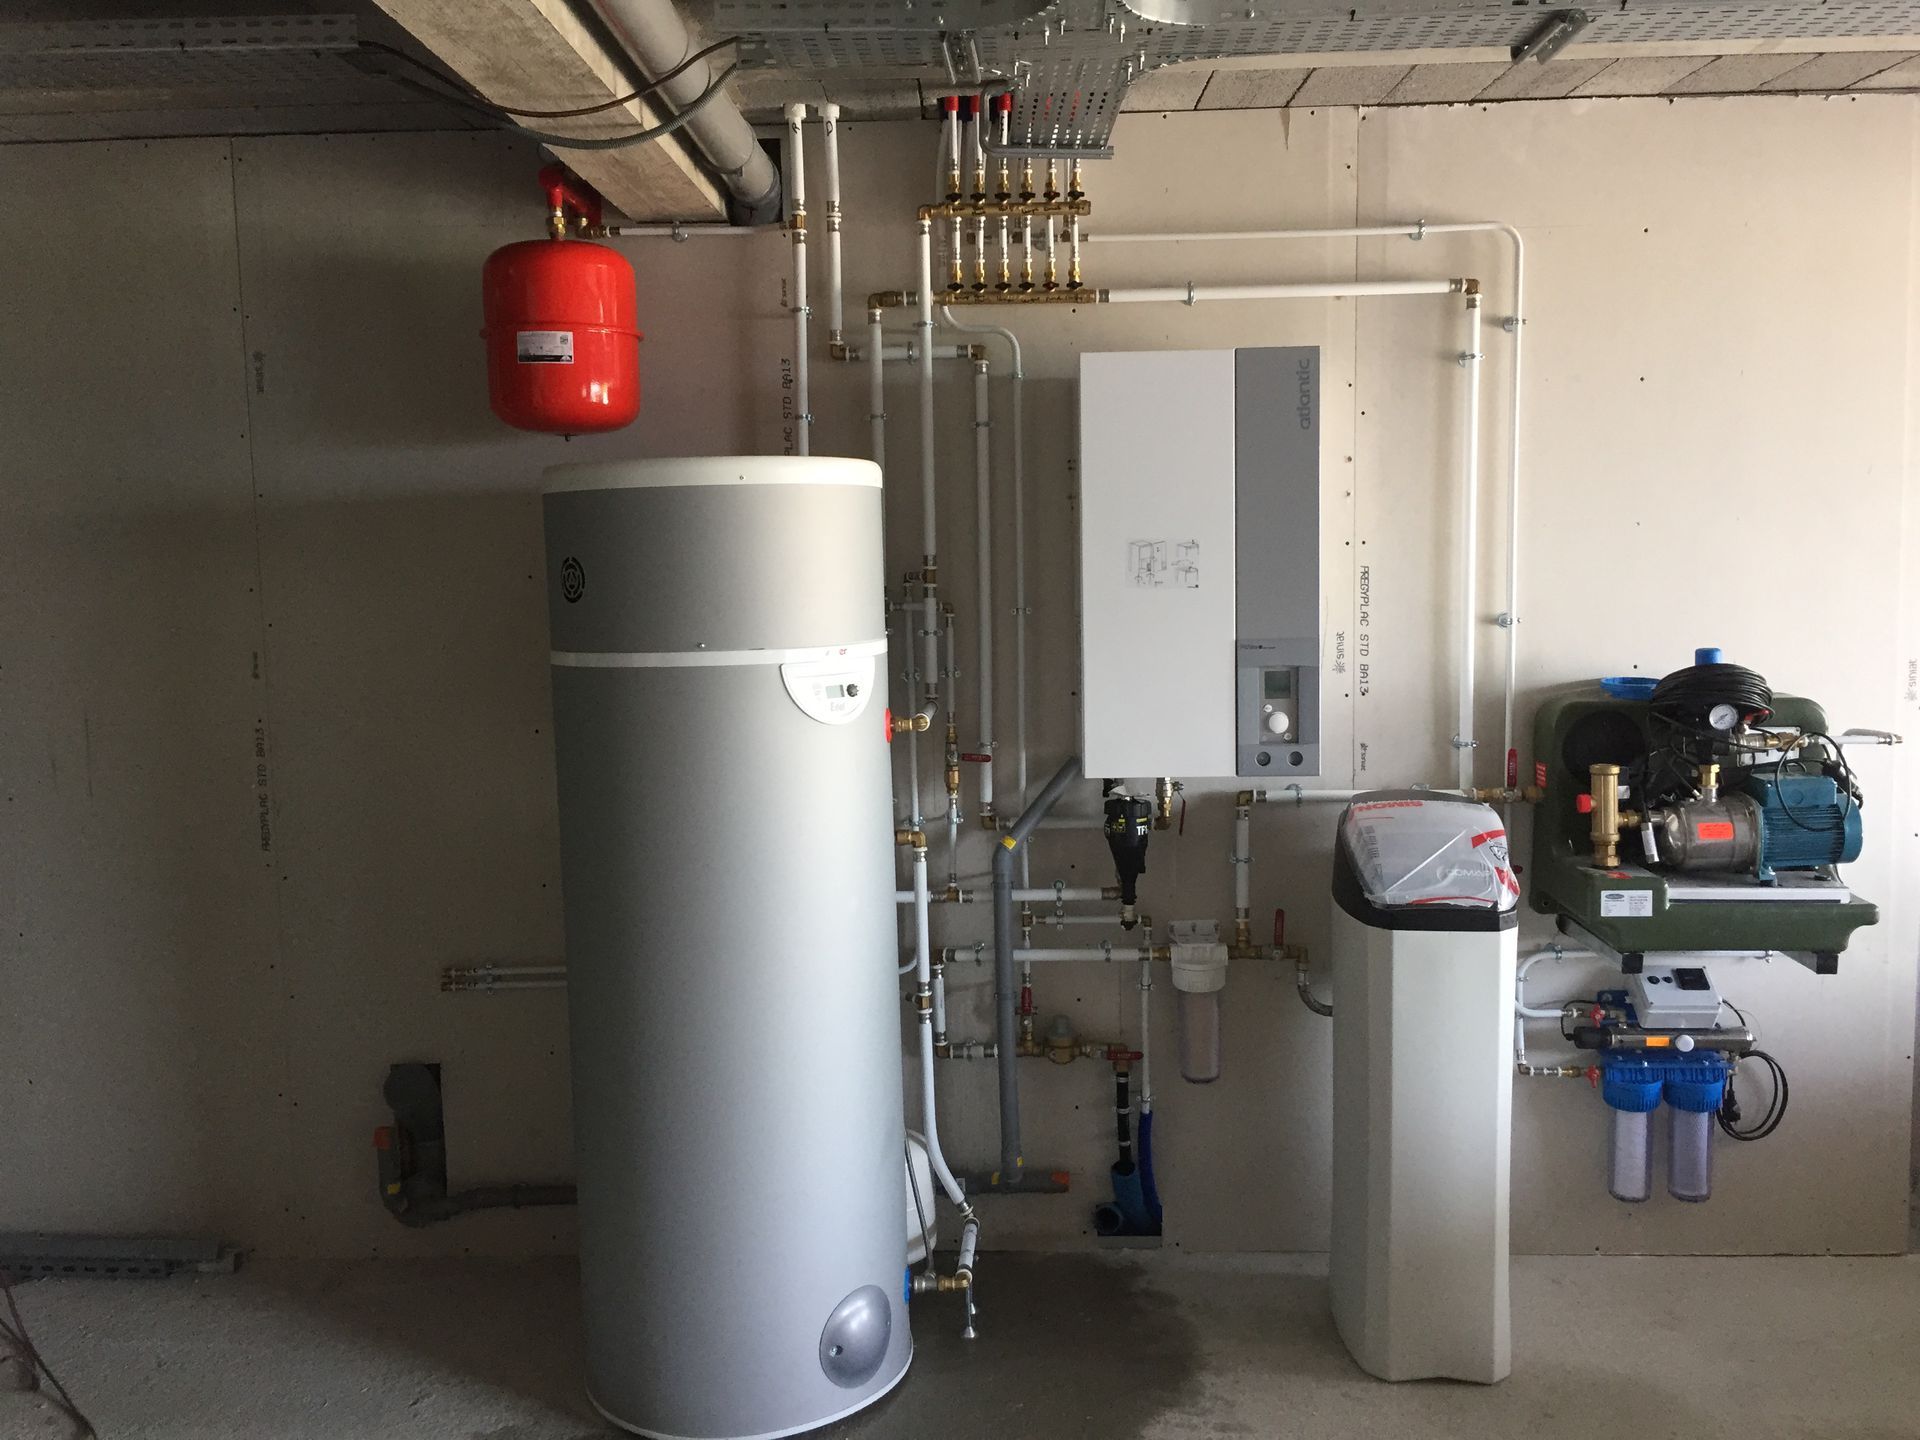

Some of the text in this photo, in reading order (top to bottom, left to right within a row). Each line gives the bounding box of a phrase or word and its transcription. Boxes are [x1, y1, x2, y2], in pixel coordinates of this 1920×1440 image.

[781, 358, 793, 390] BA13
[782, 396, 792, 420] STD
[1296, 359, 1311, 430] atlantic
[1360, 565, 1370, 694] PREGYPLAC STD BA13
[1336, 630, 1345, 660] siniat
[1908, 658, 1918, 688] siniat
[255, 727, 265, 757] BA13
[257, 763, 267, 786] STD
